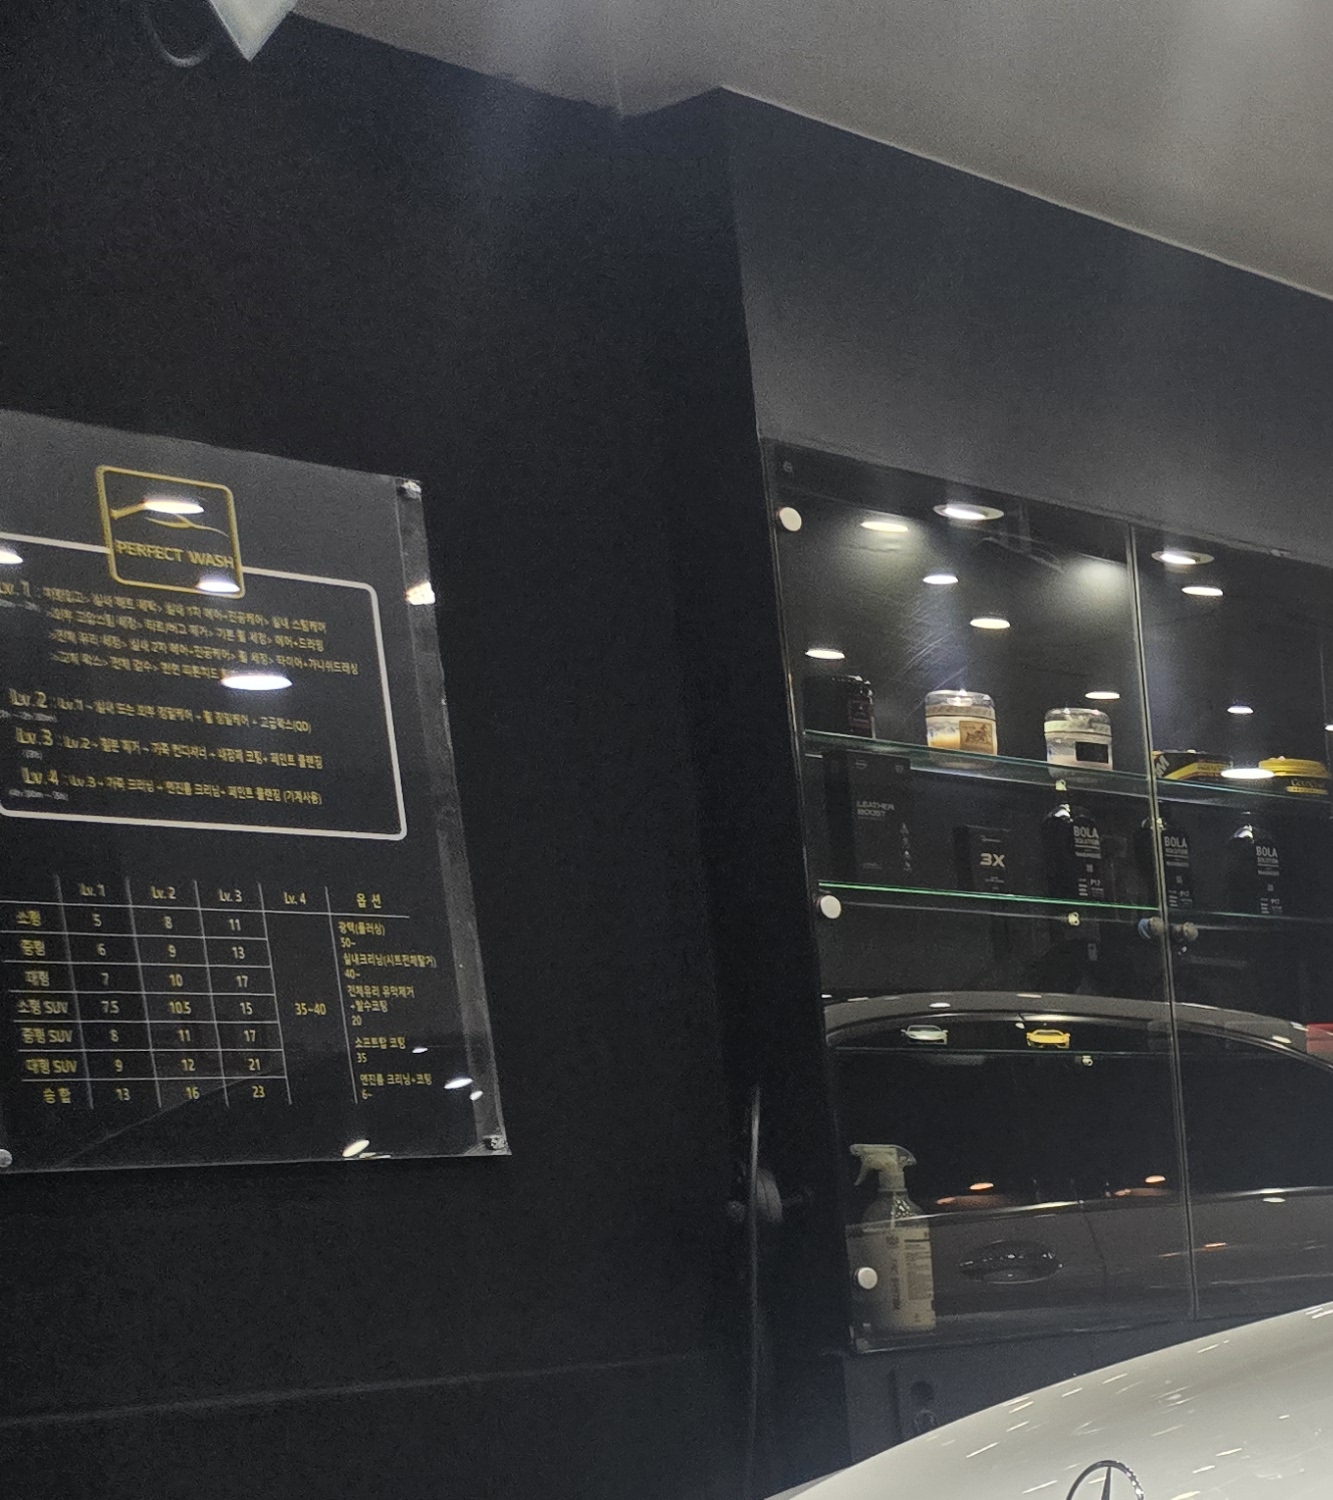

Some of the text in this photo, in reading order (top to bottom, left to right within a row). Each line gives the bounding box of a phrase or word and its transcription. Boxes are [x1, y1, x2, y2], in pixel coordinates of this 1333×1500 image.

[114, 539, 234, 569] PERFECT WASH
[1073, 826, 1099, 838] BOLA
[1164, 836, 1188, 848] BOLA
[1256, 846, 1278, 858] BOLA
[980, 853, 1005, 868] 3X
[92, 913, 102, 927] 5
[163, 915, 173, 929] 8
[229, 919, 242, 931] 11
[97, 943, 106, 956] 6
[167, 944, 176, 958] 9
[231, 946, 245, 959] 13
[100, 972, 109, 986] 7
[169, 974, 183, 987] 10
[236, 975, 248, 988] 17
[45, 1000, 68, 1014] SUV
[239, 1002, 254, 1016] 15
[295, 1002, 328, 1016] 35~40
[352, 1015, 363, 1027] 20
[49, 1029, 73, 1043] SUV
[177, 1029, 191, 1043] 11
[244, 1029, 257, 1043] 17
[114, 1058, 123, 1072] 9
[181, 1058, 196, 1072] 12
[248, 1058, 261, 1071] 21
[357, 1052, 368, 1064] 35
[53, 1060, 77, 1073] SUV
[115, 1087, 131, 1101] 13
[185, 1086, 200, 1100] 16
[252, 1085, 266, 1099] 23
